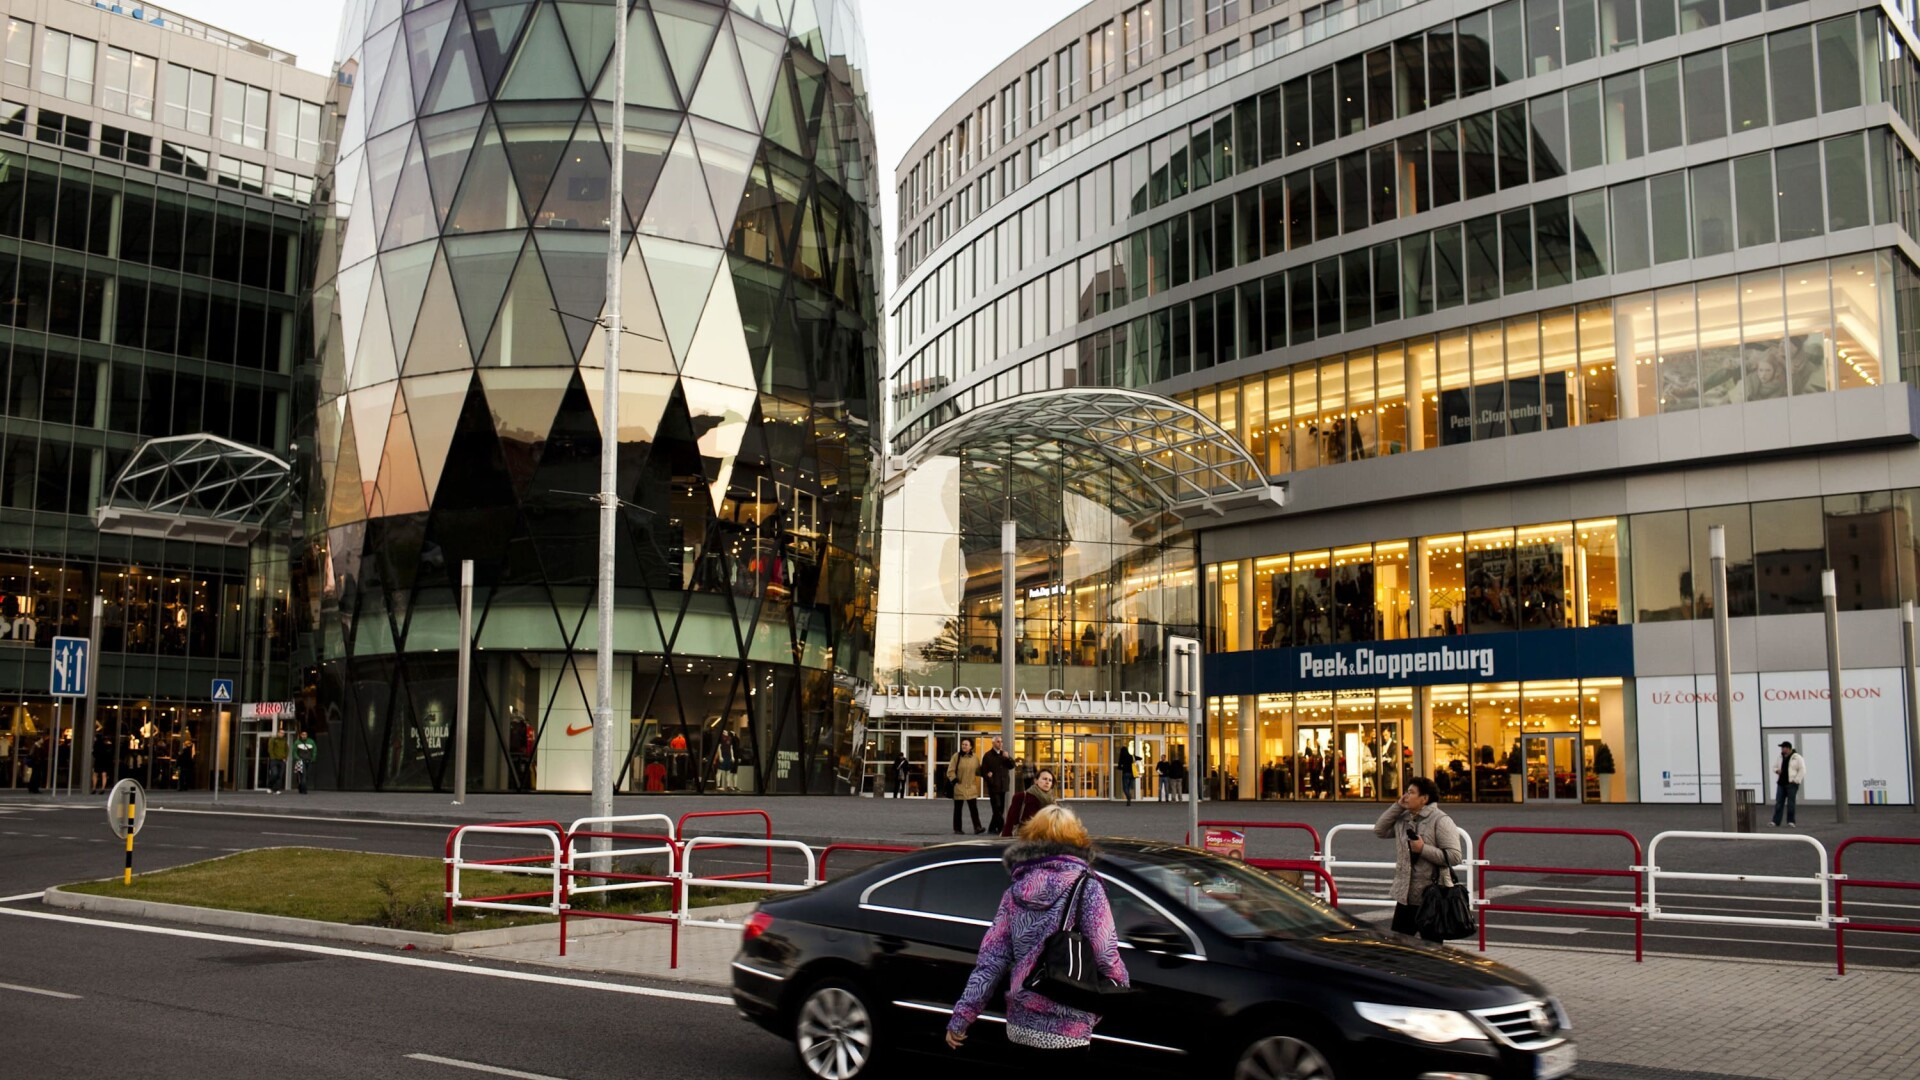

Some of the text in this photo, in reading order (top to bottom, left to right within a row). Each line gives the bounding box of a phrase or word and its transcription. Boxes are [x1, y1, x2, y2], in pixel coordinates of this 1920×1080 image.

[1300, 646, 1494, 679] Peek&Cloppenburg
[884, 684, 1031, 713] EUROVA
[1652, 690, 1671, 704] UŽ
[1840, 687, 1881, 700] OON
[416, 737, 442, 749] SELA
